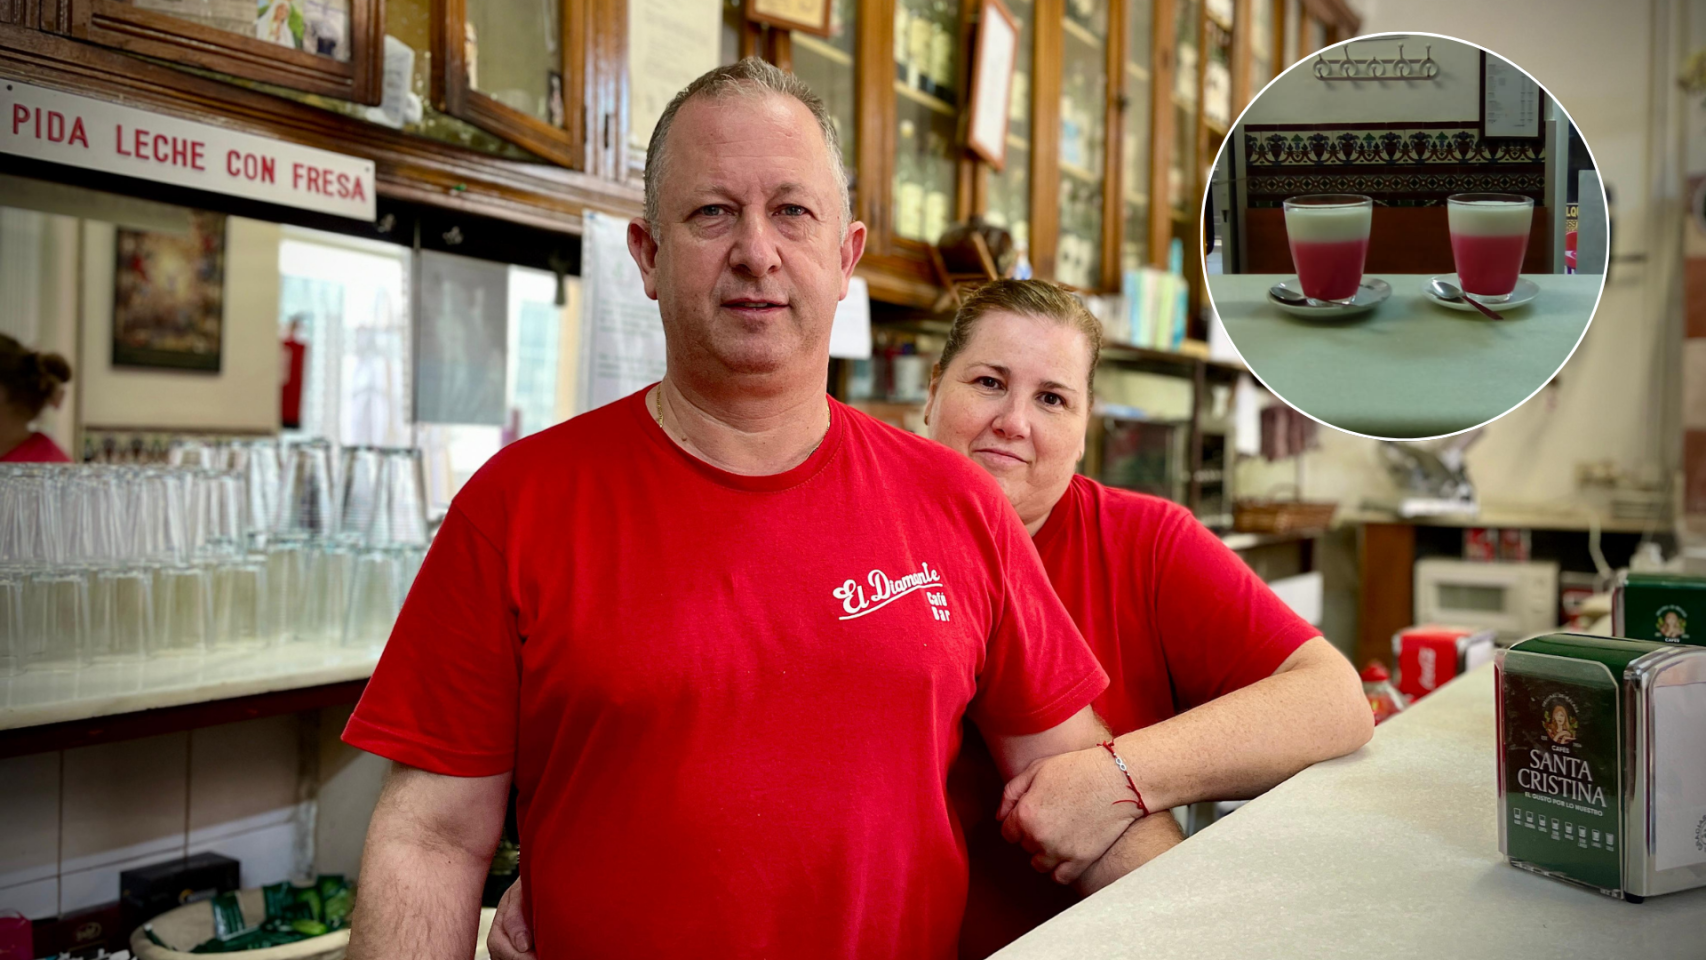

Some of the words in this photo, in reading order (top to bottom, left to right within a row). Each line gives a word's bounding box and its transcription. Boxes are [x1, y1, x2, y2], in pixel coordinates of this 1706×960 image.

[12, 103, 90, 148] PIDA
[115, 124, 206, 171] LECHE
[226, 149, 276, 184] CON
[292, 163, 367, 202] FRESA
[832, 579, 870, 613] El
[931, 606, 950, 621] Bar
[1529, 749, 1593, 782] SANTA
[1517, 768, 1607, 808] CRISTINA
[1532, 793, 1552, 803] GUSTO
[1552, 798, 1565, 806] POR
[1575, 804, 1603, 816] NUESTRO
